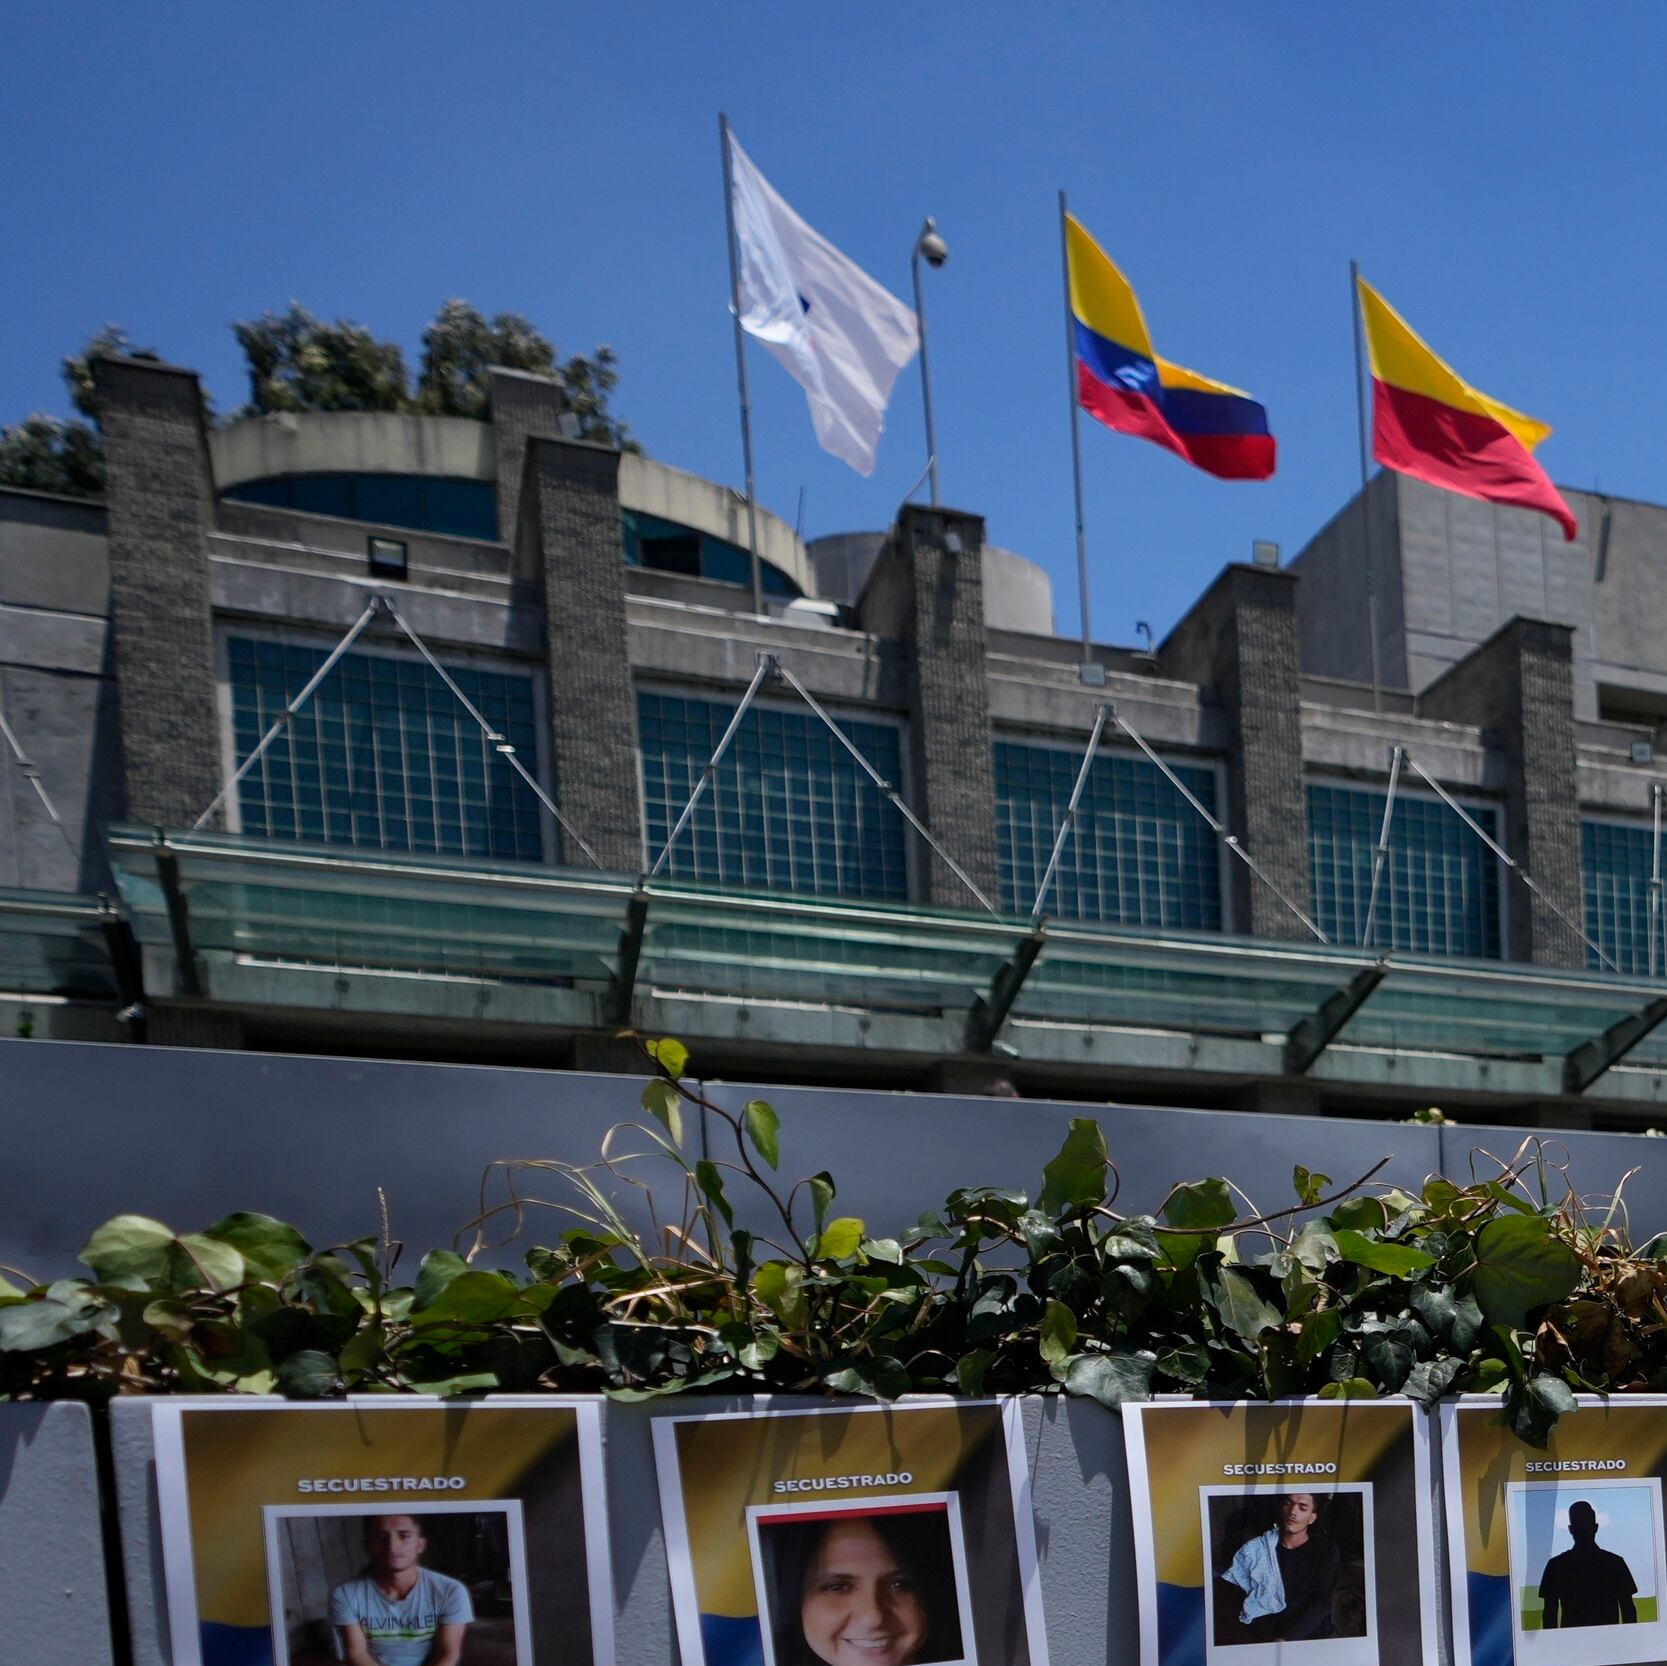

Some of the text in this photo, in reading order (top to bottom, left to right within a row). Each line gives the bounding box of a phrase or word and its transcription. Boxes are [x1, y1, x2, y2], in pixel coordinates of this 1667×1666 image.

[1224, 1462, 1336, 1475] SECUESTRADO
[1525, 1459, 1626, 1472] SECUESTRADO
[298, 1476, 466, 1492] SECUESTRADO
[774, 1472, 912, 1493] SECUESTRADO
